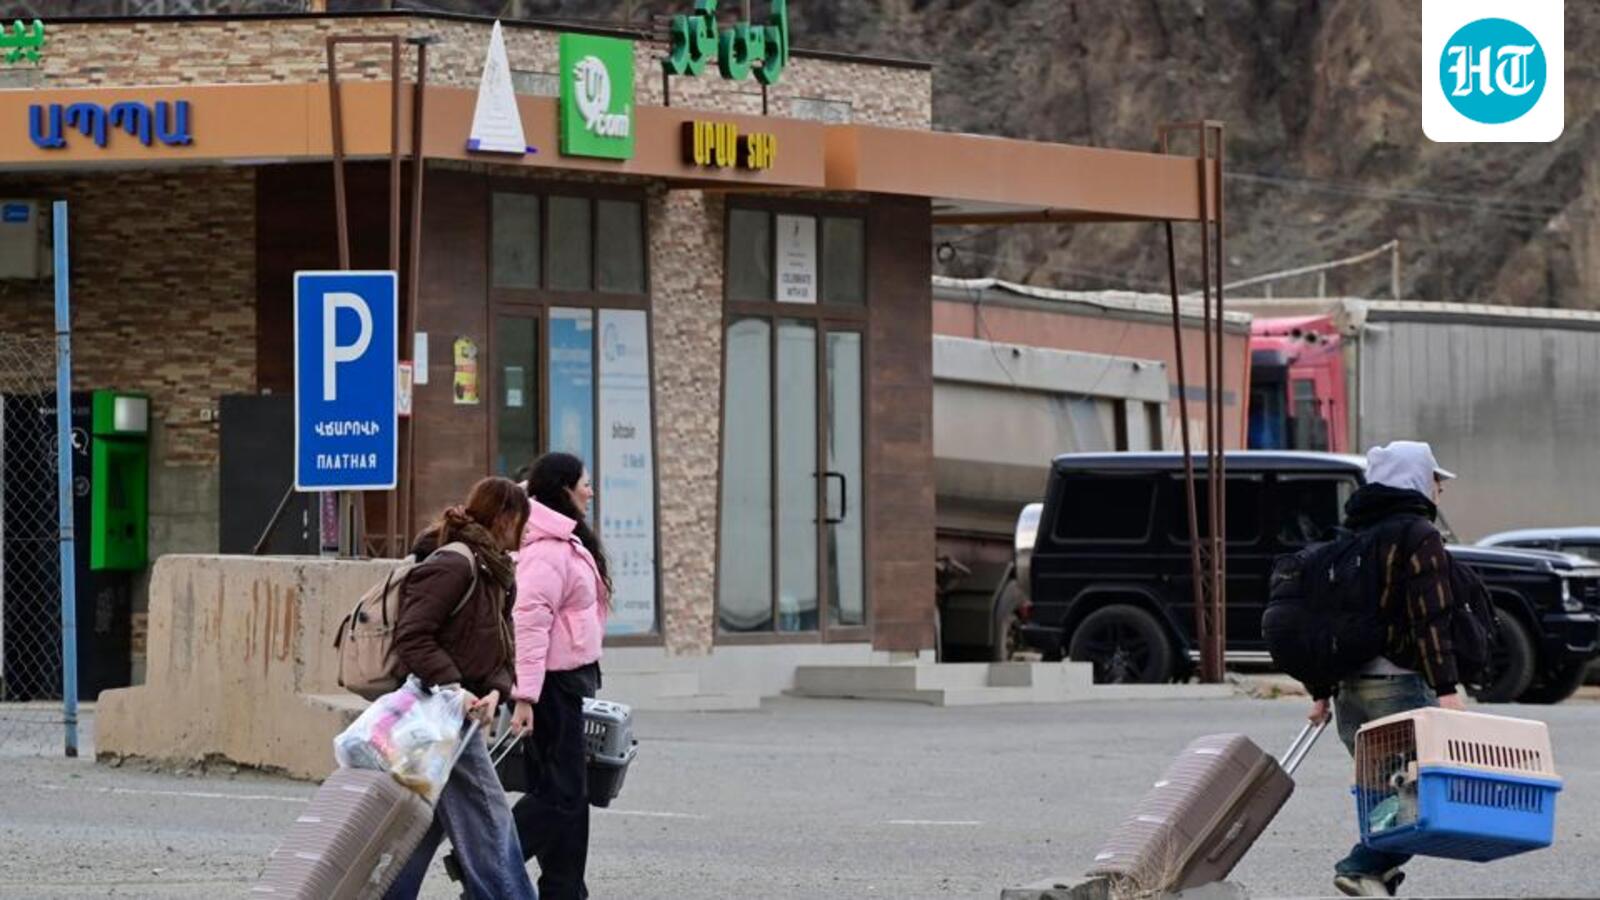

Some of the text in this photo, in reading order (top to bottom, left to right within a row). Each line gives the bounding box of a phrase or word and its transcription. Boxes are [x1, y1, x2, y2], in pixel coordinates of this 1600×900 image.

[28, 99, 193, 149] ԱՊՊԱ
[323, 292, 373, 402] P
[316, 453, 378, 471] ПЛАТНАЯ
